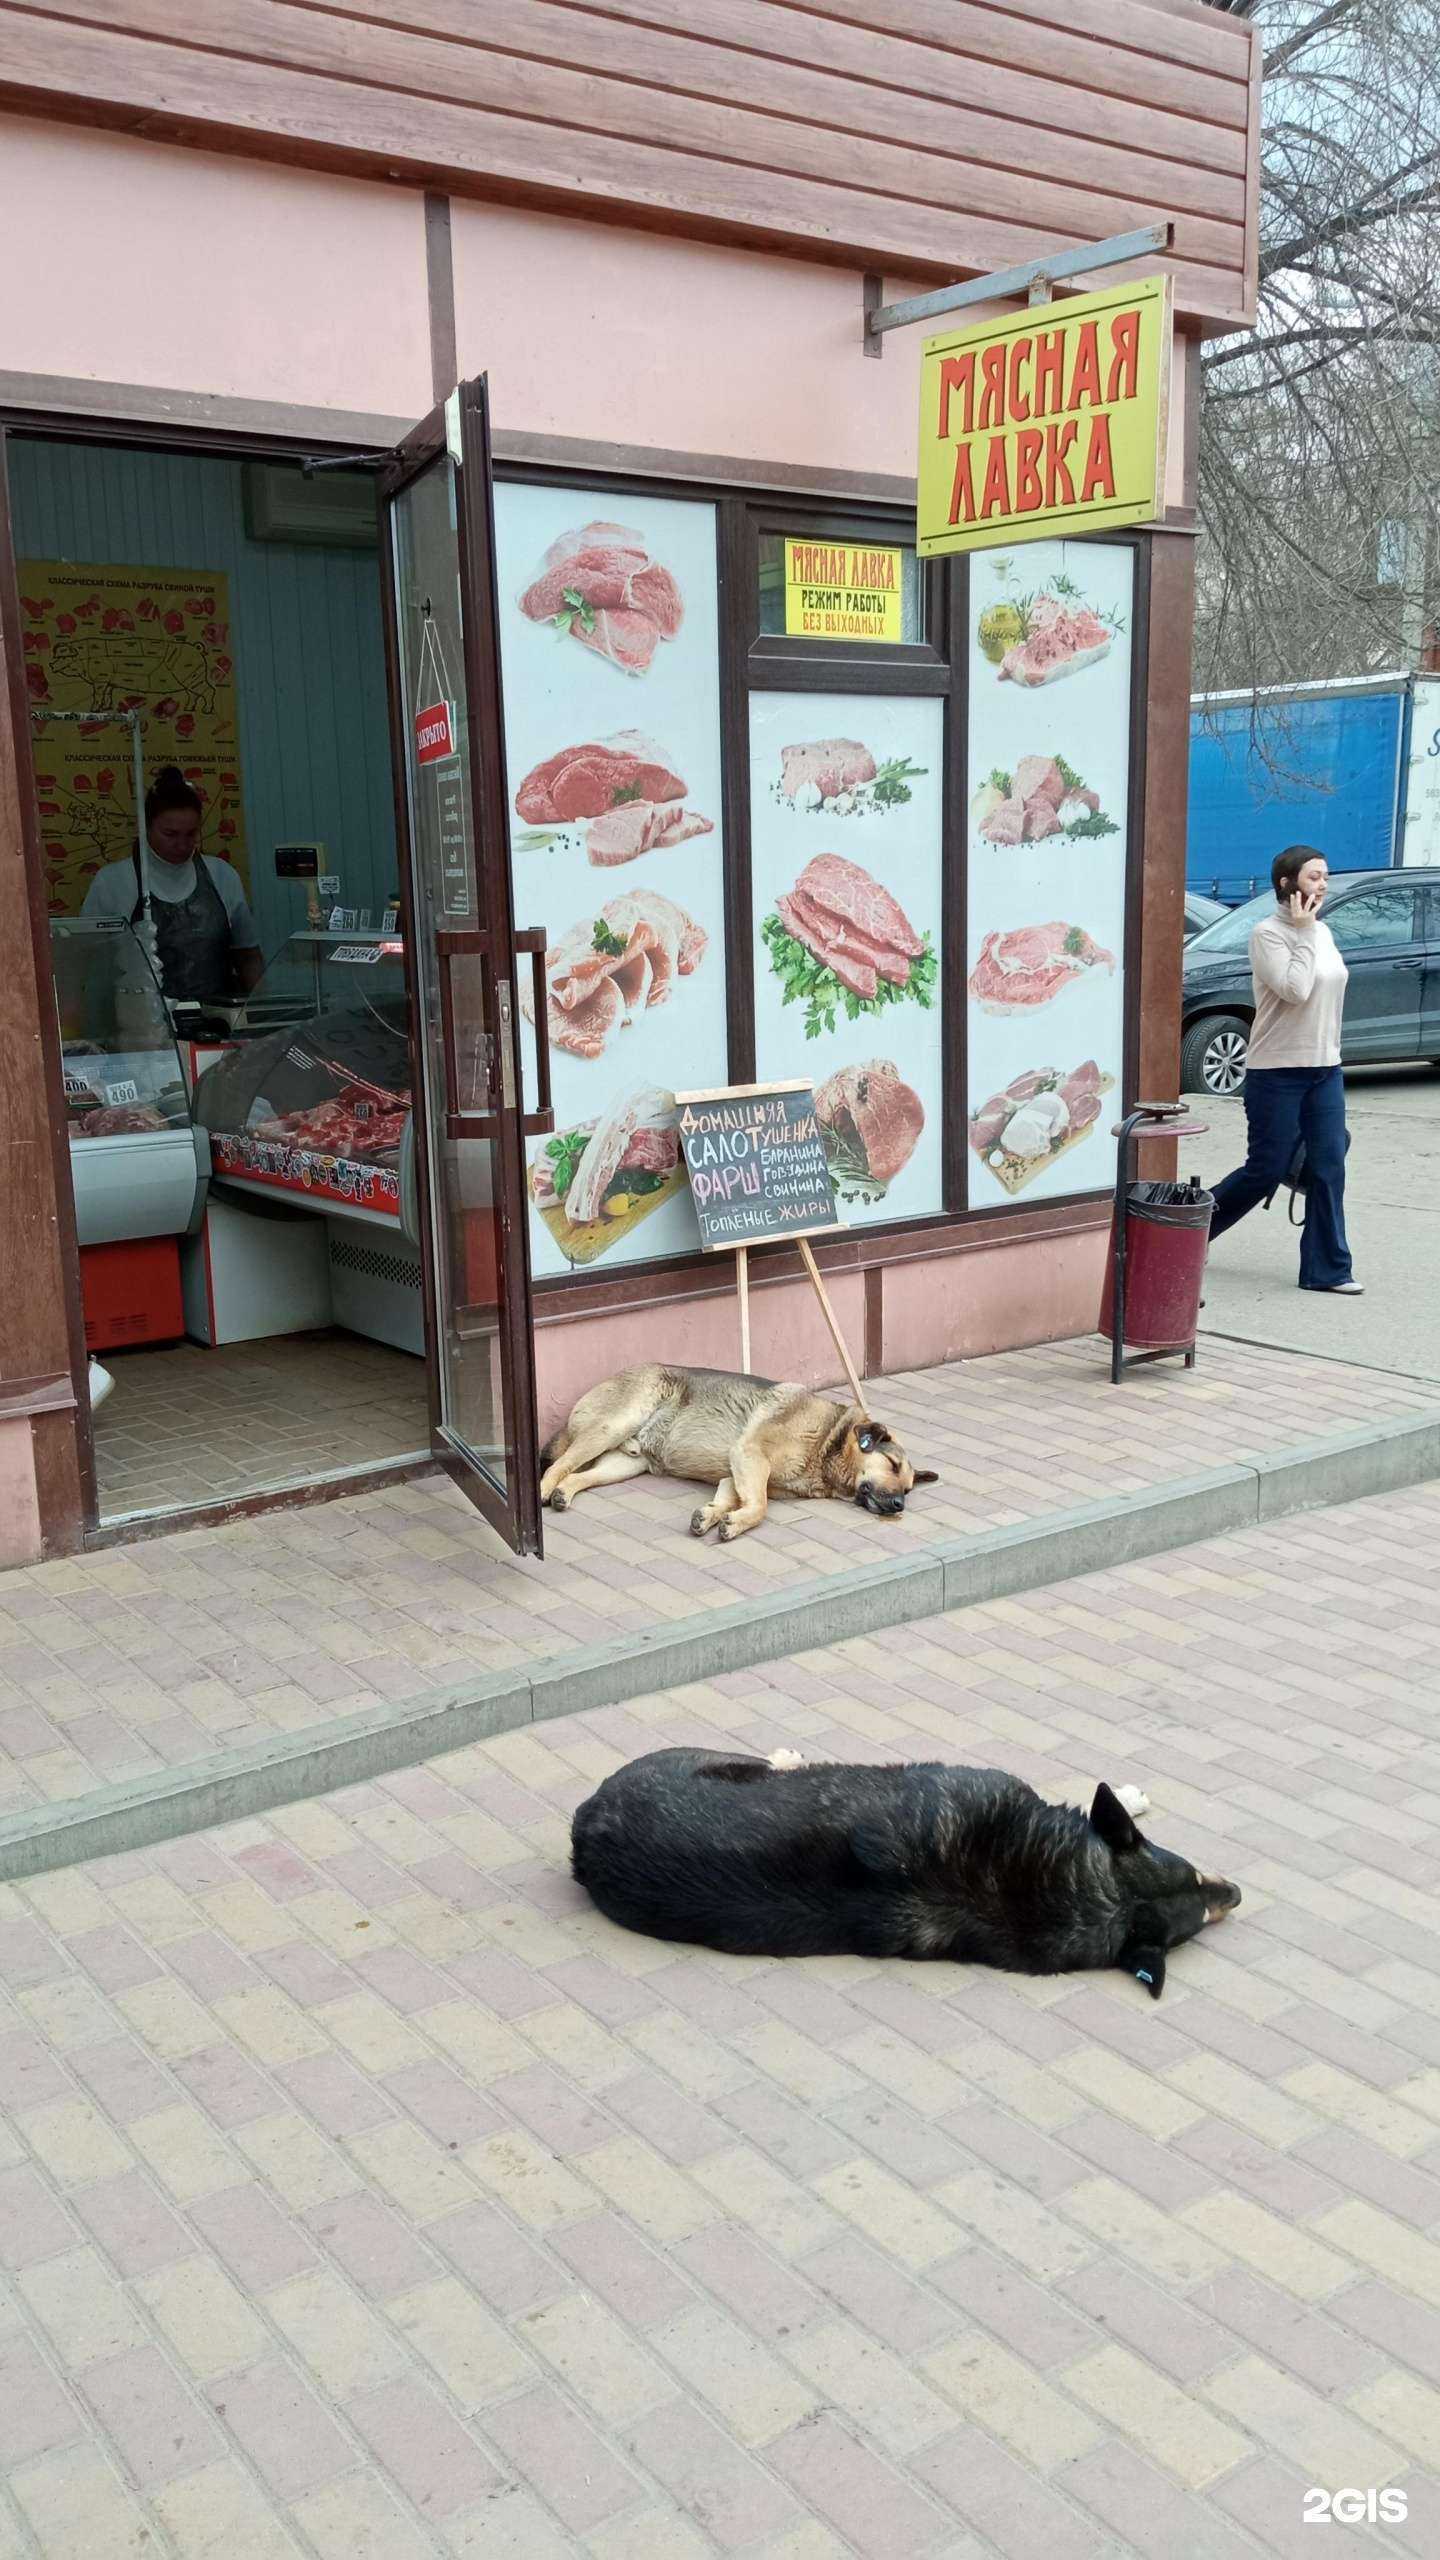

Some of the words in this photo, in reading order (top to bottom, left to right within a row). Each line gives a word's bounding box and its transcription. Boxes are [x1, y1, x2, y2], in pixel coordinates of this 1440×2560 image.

[937, 310, 1142, 439] МЯСНАЯ
[947, 413, 1116, 525] ЛАВКА
[792, 545, 846, 586] МЯСНАЯ
[851, 552, 895, 589] ЛАВКА
[801, 589, 842, 611] РЕЖИМ
[846, 593, 886, 614] РАБОТЫ
[803, 612, 822, 631] БЕЗ
[825, 613, 885, 636] ВЫХОДНЫХ
[416, 721, 447, 750] ЗАКРЫТО
[112, 1087, 135, 1104] 490
[746, 1114, 819, 1152] ТУШЕНКА
[687, 1130, 749, 1168] САЛО
[760, 1144, 823, 1165] БАРАНИНА
[692, 1162, 761, 1206] ФАРШ
[765, 1178, 825, 1198] СВИНИНА
[777, 1200, 831, 1222] ЖИРЫ
